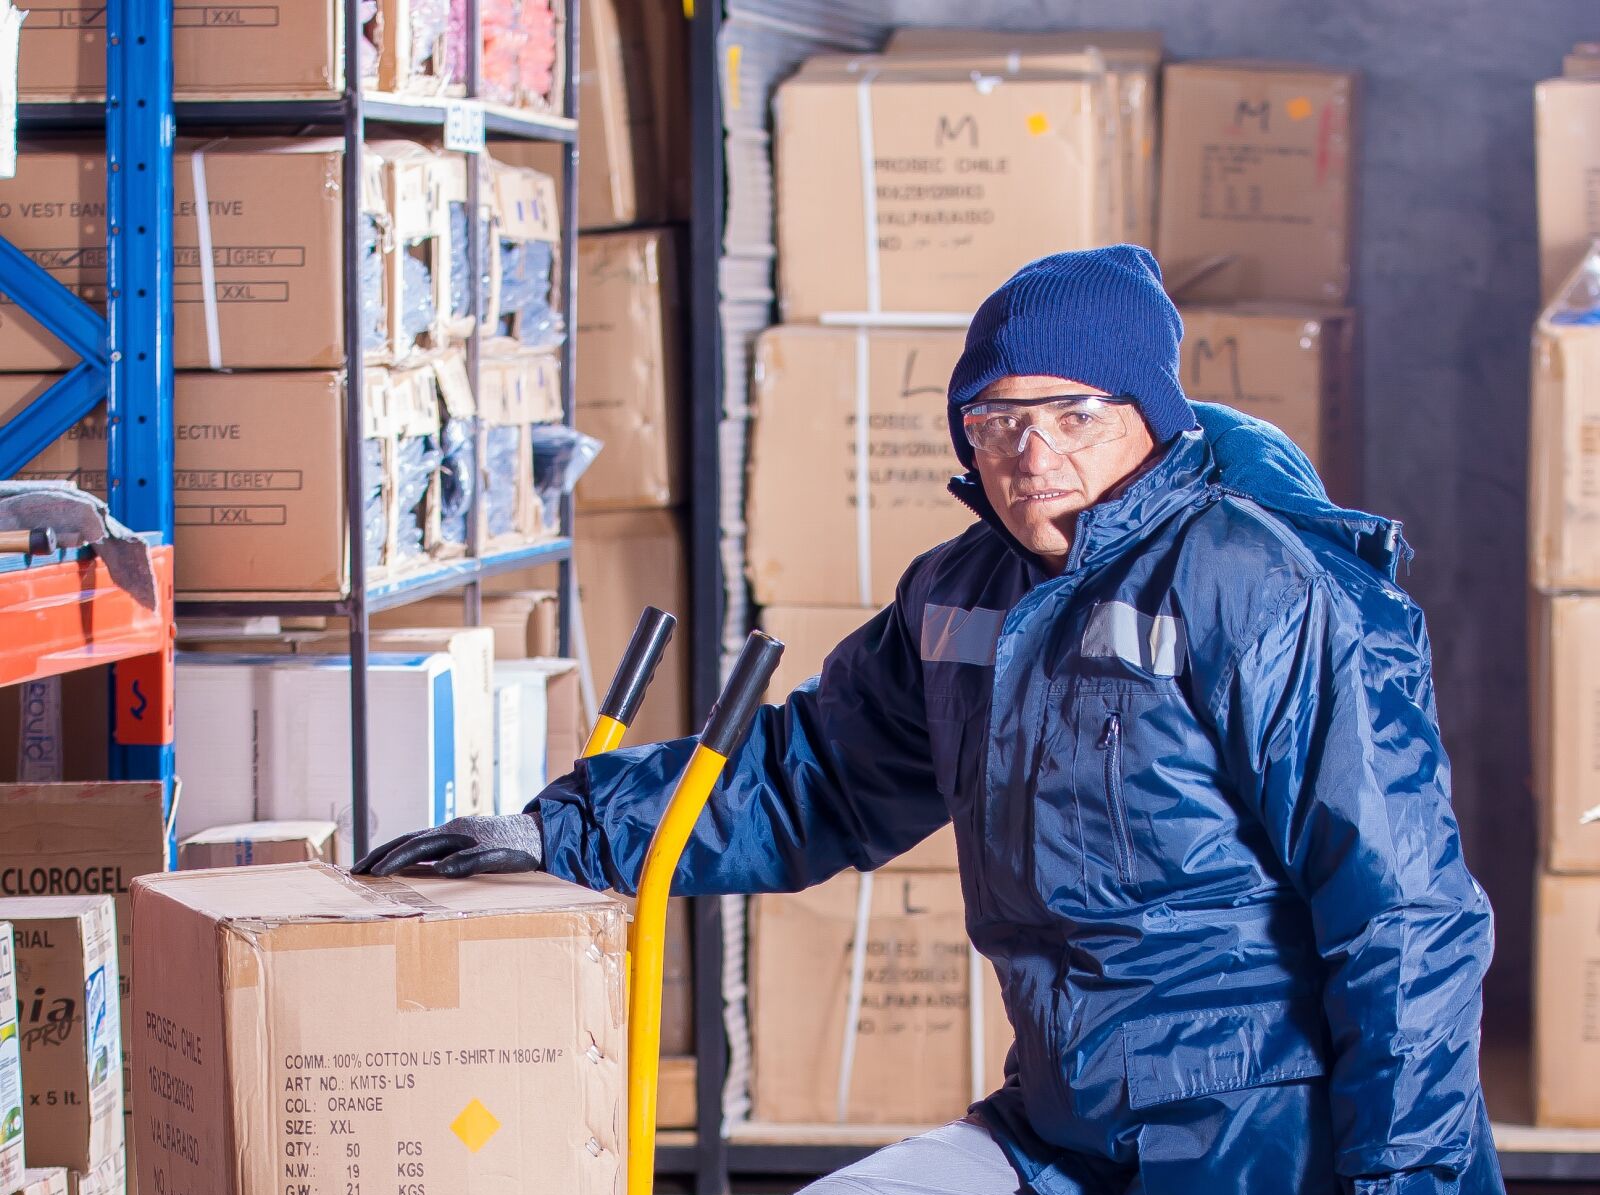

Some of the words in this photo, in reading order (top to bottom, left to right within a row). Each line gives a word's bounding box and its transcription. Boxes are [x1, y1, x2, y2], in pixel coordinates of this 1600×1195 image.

[213, 10, 245, 24] XXL
[1234, 99, 1270, 133] M
[935, 112, 979, 149] M
[19, 202, 65, 218] VEST
[70, 202, 105, 218] BAN
[234, 249, 276, 264] GREY
[222, 285, 255, 299] XXL
[903, 349, 945, 397] L
[176, 424, 240, 440] ECTIVE
[231, 473, 274, 488] GREY
[220, 508, 253, 522] XXL
[1, 866, 128, 896] CLOROGEL
[14, 931, 54, 948] RIAL
[18, 987, 75, 1024] ia
[146, 1012, 177, 1050] PROSEC
[181, 1028, 202, 1065] CHILE
[333, 1055, 362, 1069] 100%
[366, 1052, 418, 1067] COTTON
[423, 1051, 441, 1065] L/S
[499, 1049, 510, 1064] IN
[285, 1077, 310, 1091] ART
[47, 1090, 58, 1106] 5
[285, 1098, 316, 1113] COL:
[328, 1097, 383, 1111] ORANGE
[285, 1120, 316, 1135] SIZE:
[330, 1120, 355, 1134] XXL
[151, 1117, 199, 1166] VALPARAISO
[347, 1144, 360, 1157] 50
[398, 1141, 422, 1155] PCS
[347, 1164, 360, 1178] 19
[397, 1163, 424, 1177] KGS
